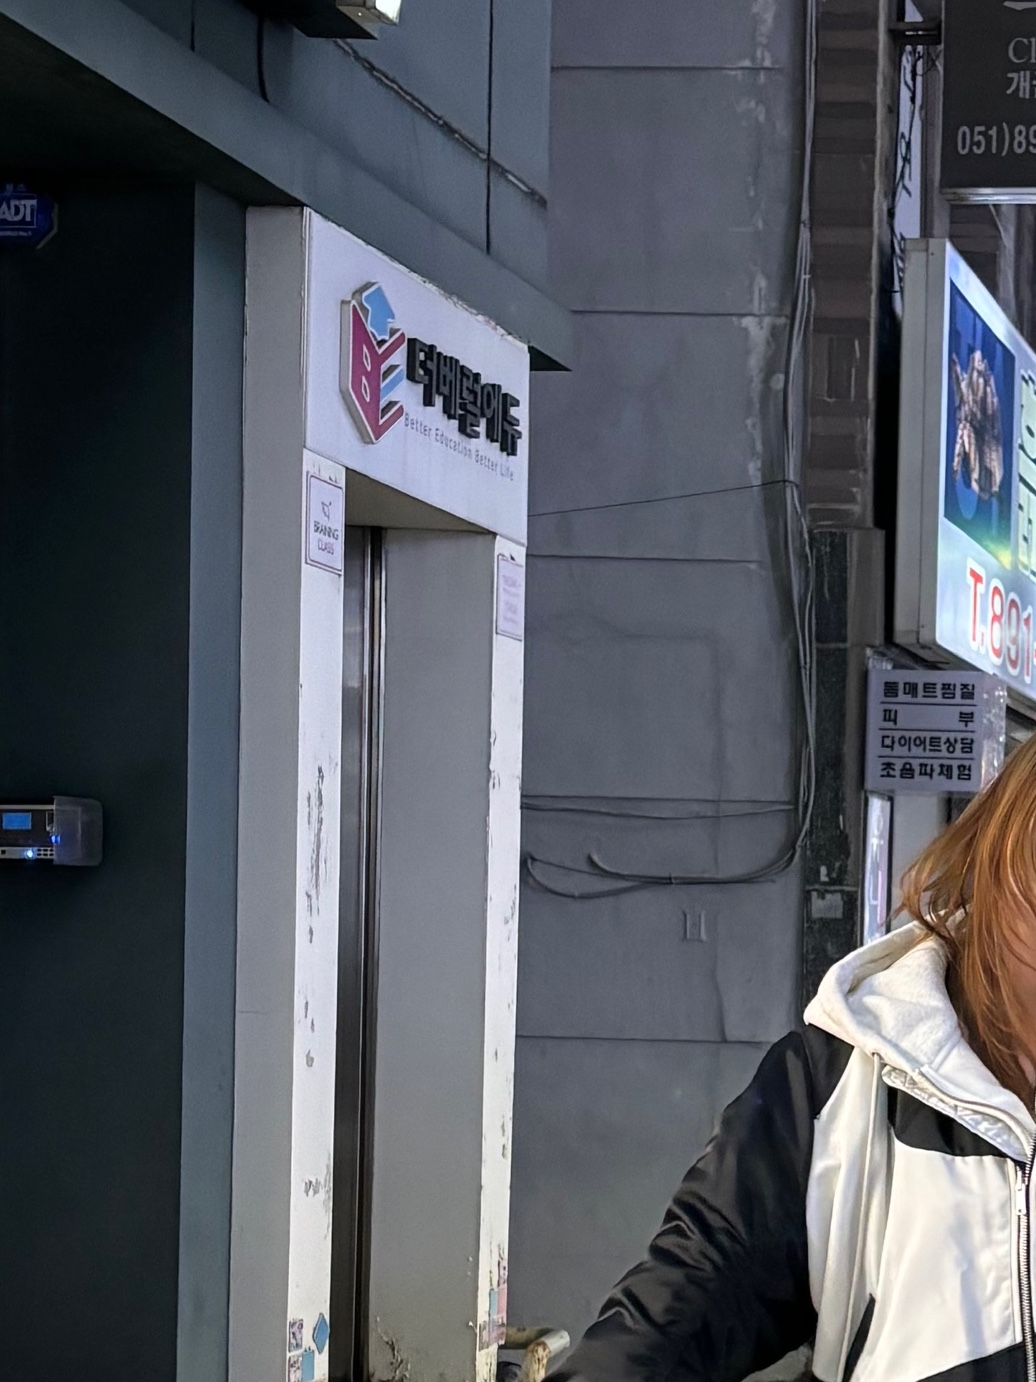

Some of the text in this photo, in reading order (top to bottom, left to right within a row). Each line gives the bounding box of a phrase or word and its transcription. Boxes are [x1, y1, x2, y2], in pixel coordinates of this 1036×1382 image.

[0, 199, 37, 221] ADT
[404, 412, 432, 437] Better
[435, 428, 473, 461] Education
[474, 450, 499, 477] Better
[881, 735, 975, 754] 다이어트상담
[880, 761, 972, 781] 초음파체험
